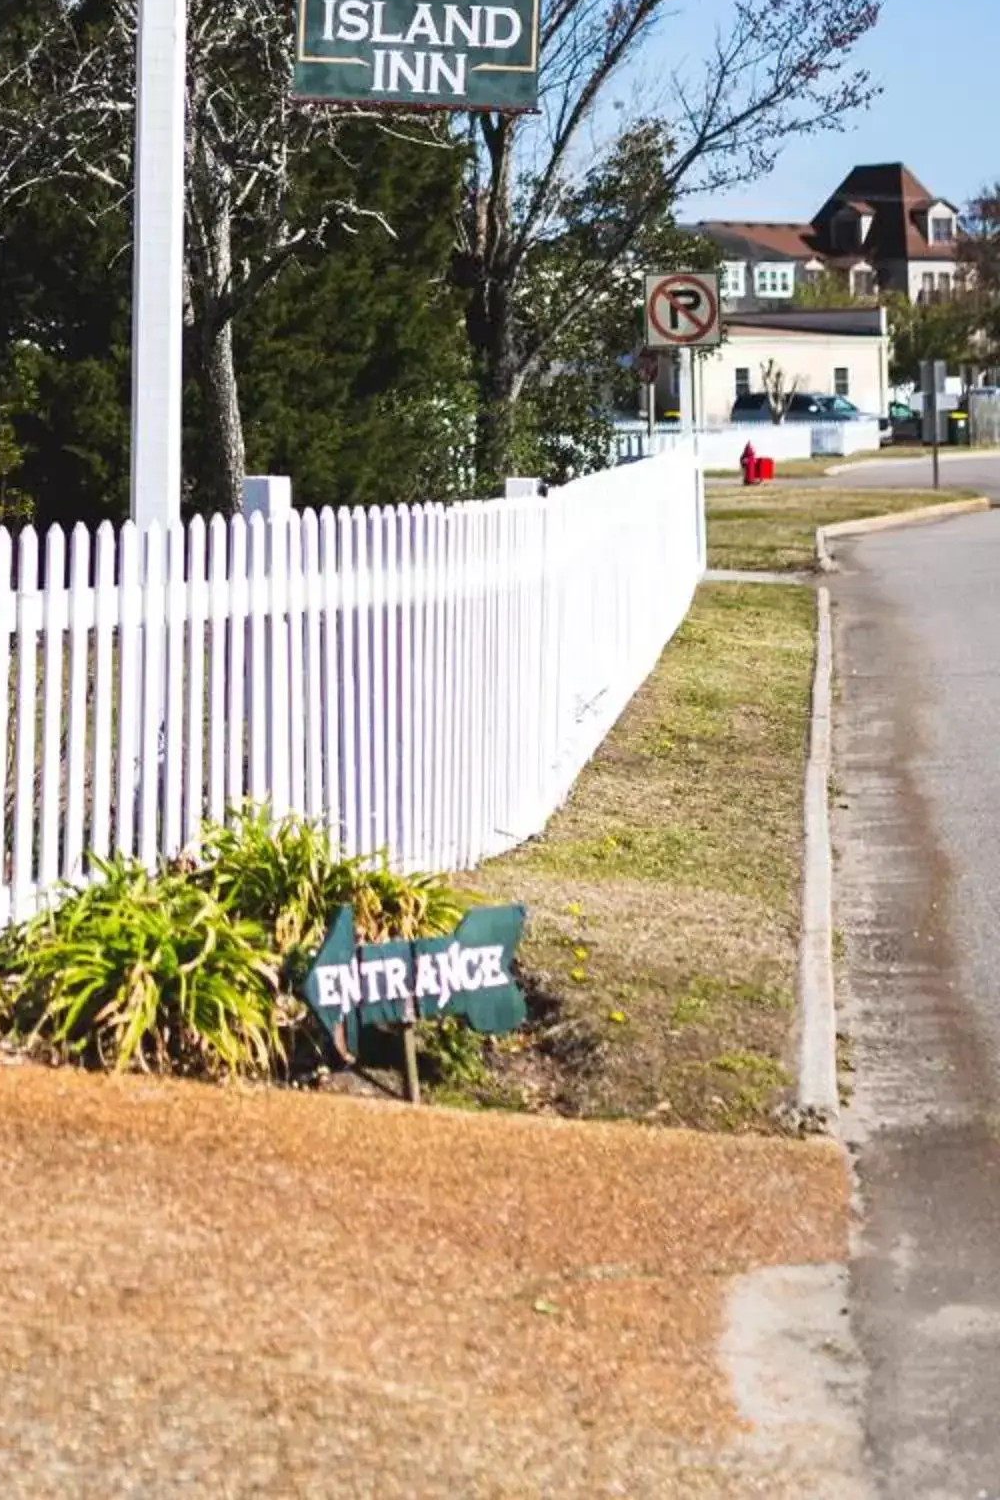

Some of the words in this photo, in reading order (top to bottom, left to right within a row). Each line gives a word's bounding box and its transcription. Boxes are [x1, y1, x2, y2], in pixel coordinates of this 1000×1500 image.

[322, 0, 523, 49] ISLAND
[371, 49, 467, 95] INN
[668, 289, 701, 329] P
[314, 941, 509, 1013] ENTRANCE
